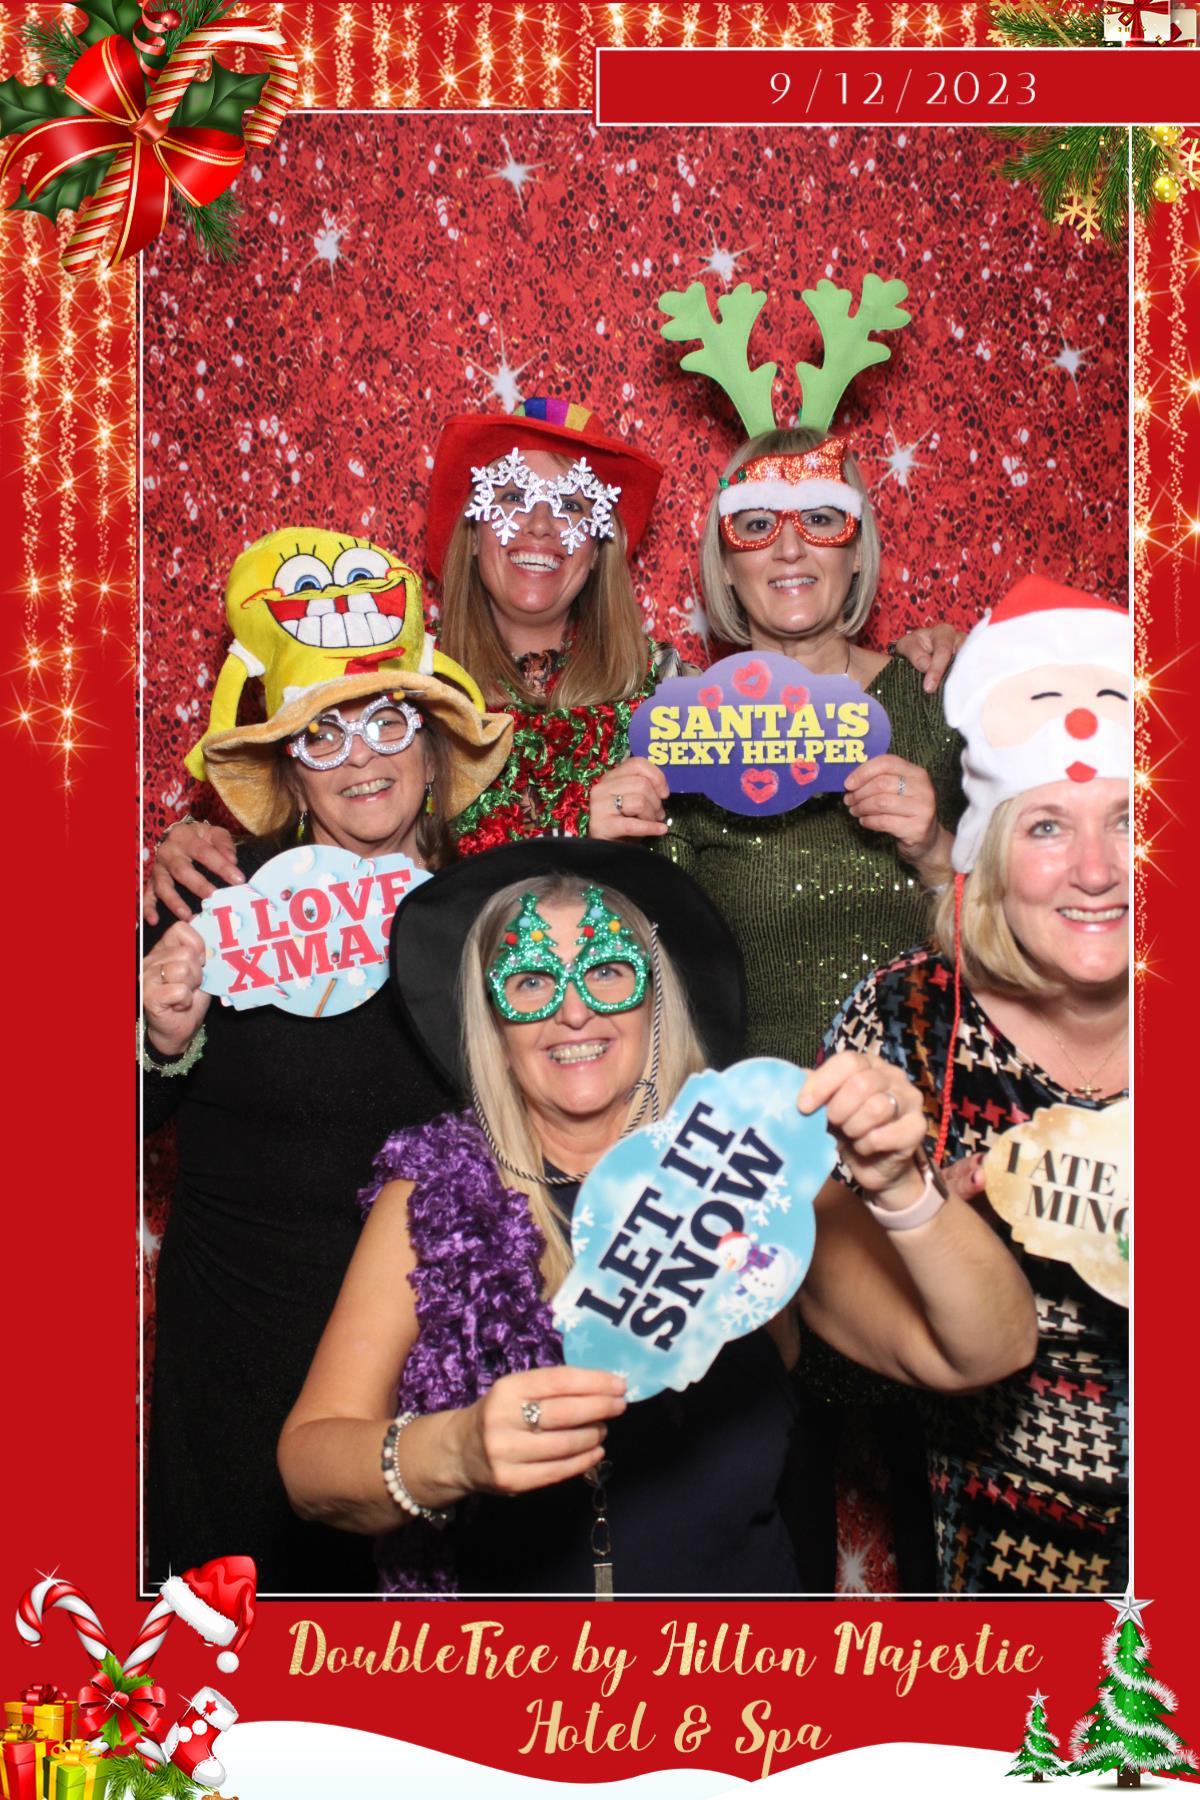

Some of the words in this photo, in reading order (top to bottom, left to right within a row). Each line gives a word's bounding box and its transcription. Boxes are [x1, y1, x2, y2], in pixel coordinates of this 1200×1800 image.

[650, 703, 870, 741] SANTA'S
[648, 741, 735, 766] SEXY
[742, 739, 868, 765] HELPER
[213, 905, 239, 949] I
[1007, 1141, 1021, 1174] I
[1030, 1149, 1118, 1197] ATE
[575, 1187, 683, 1328] LET
[660, 1101, 735, 1189] IT
[630, 1127, 784, 1352] SNOW
